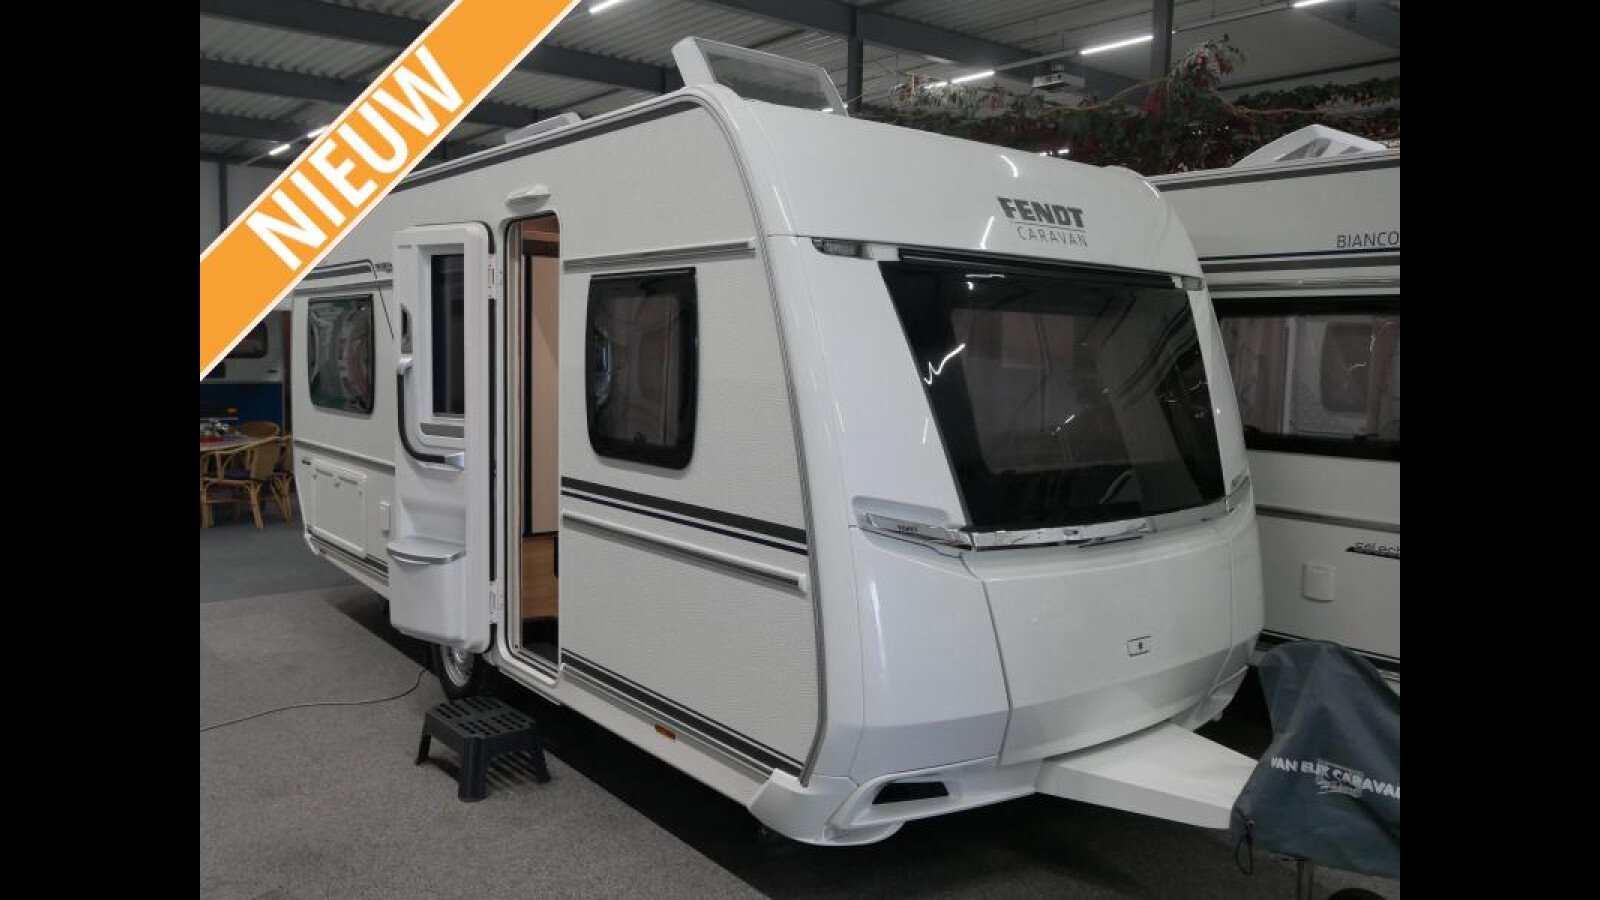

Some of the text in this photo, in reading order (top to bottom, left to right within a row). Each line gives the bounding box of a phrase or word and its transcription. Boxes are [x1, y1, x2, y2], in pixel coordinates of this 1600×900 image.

[997, 196, 1084, 229] FENDT
[1016, 226, 1088, 247] CARAVAN
[1336, 230, 1400, 248] BIANCO
[1270, 756, 1299, 772] VAN
